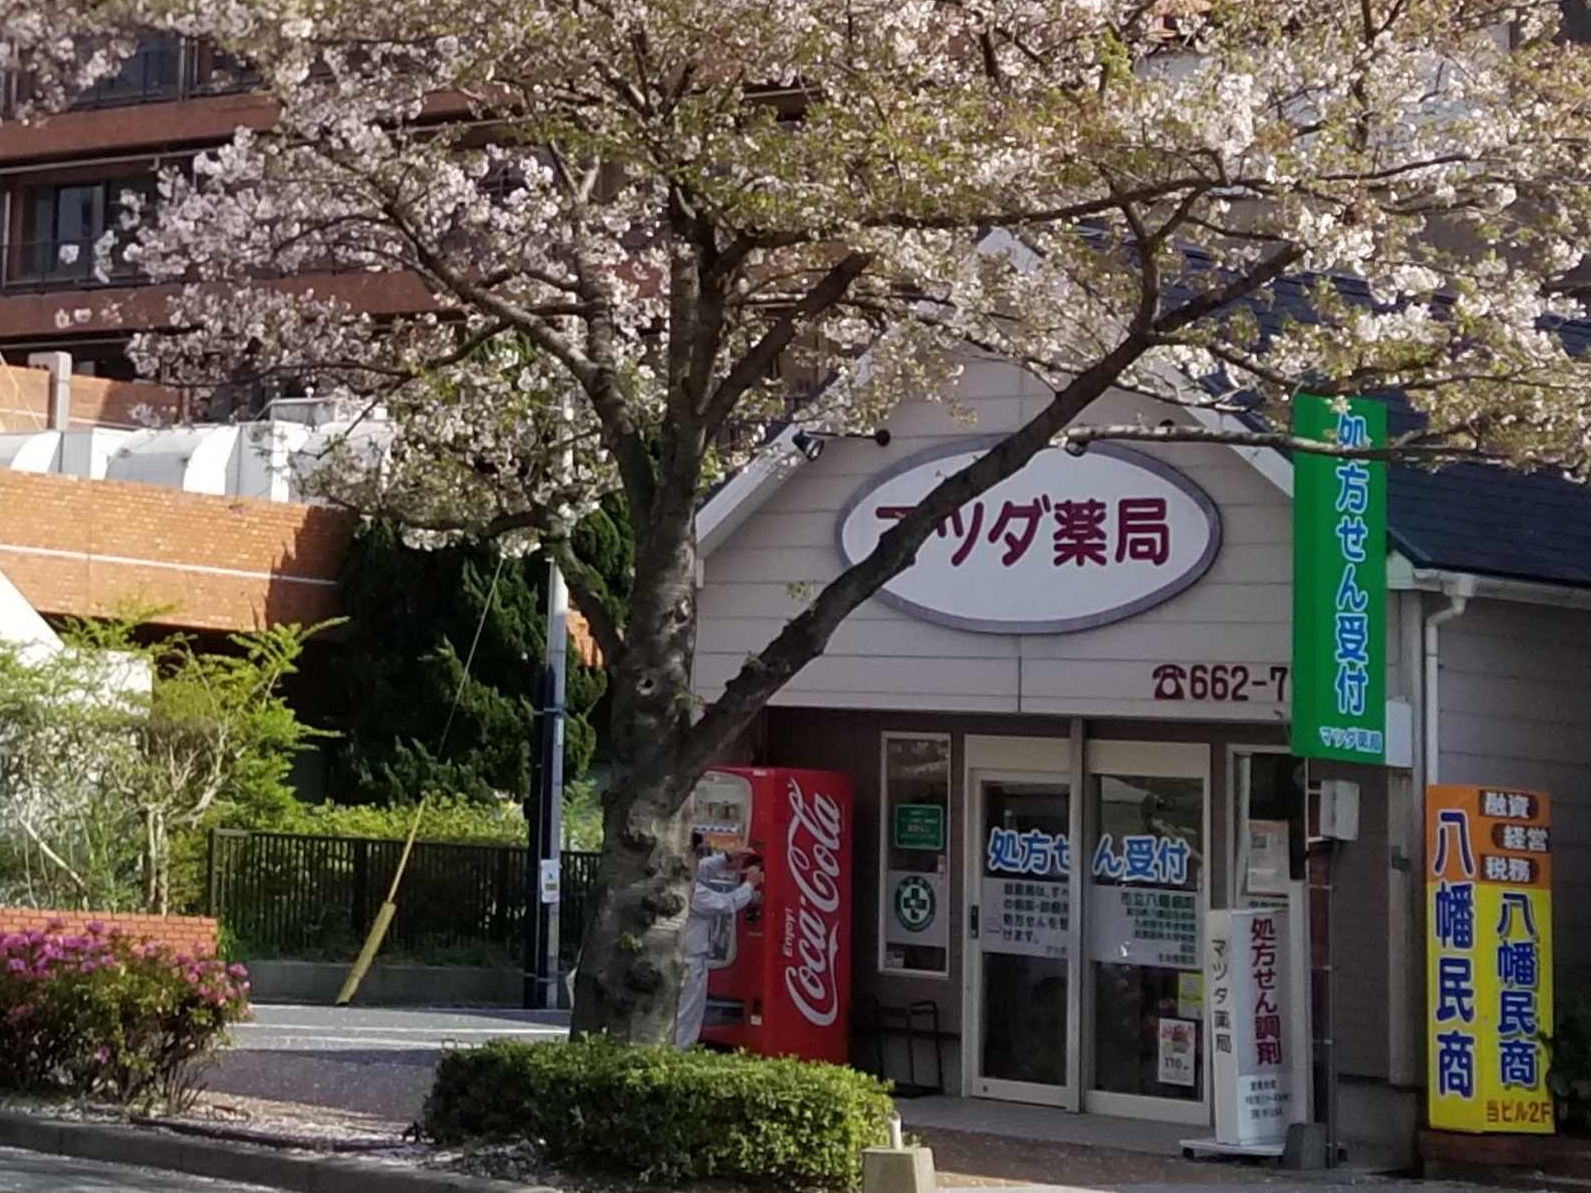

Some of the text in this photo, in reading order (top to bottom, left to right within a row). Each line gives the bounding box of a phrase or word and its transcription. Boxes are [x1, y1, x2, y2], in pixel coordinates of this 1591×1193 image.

[785, 776, 842, 1027] Coca-Cola
[1486, 856, 1530, 883] 税務
[1504, 825, 1548, 853] 経営
[1250, 917, 1284, 1067] 処方せん調剤
[1432, 809, 1475, 1100] 八幡民商
[1496, 891, 1539, 1089] 八幡民商
[1486, 1099, 1551, 1124] 当ビル2F
